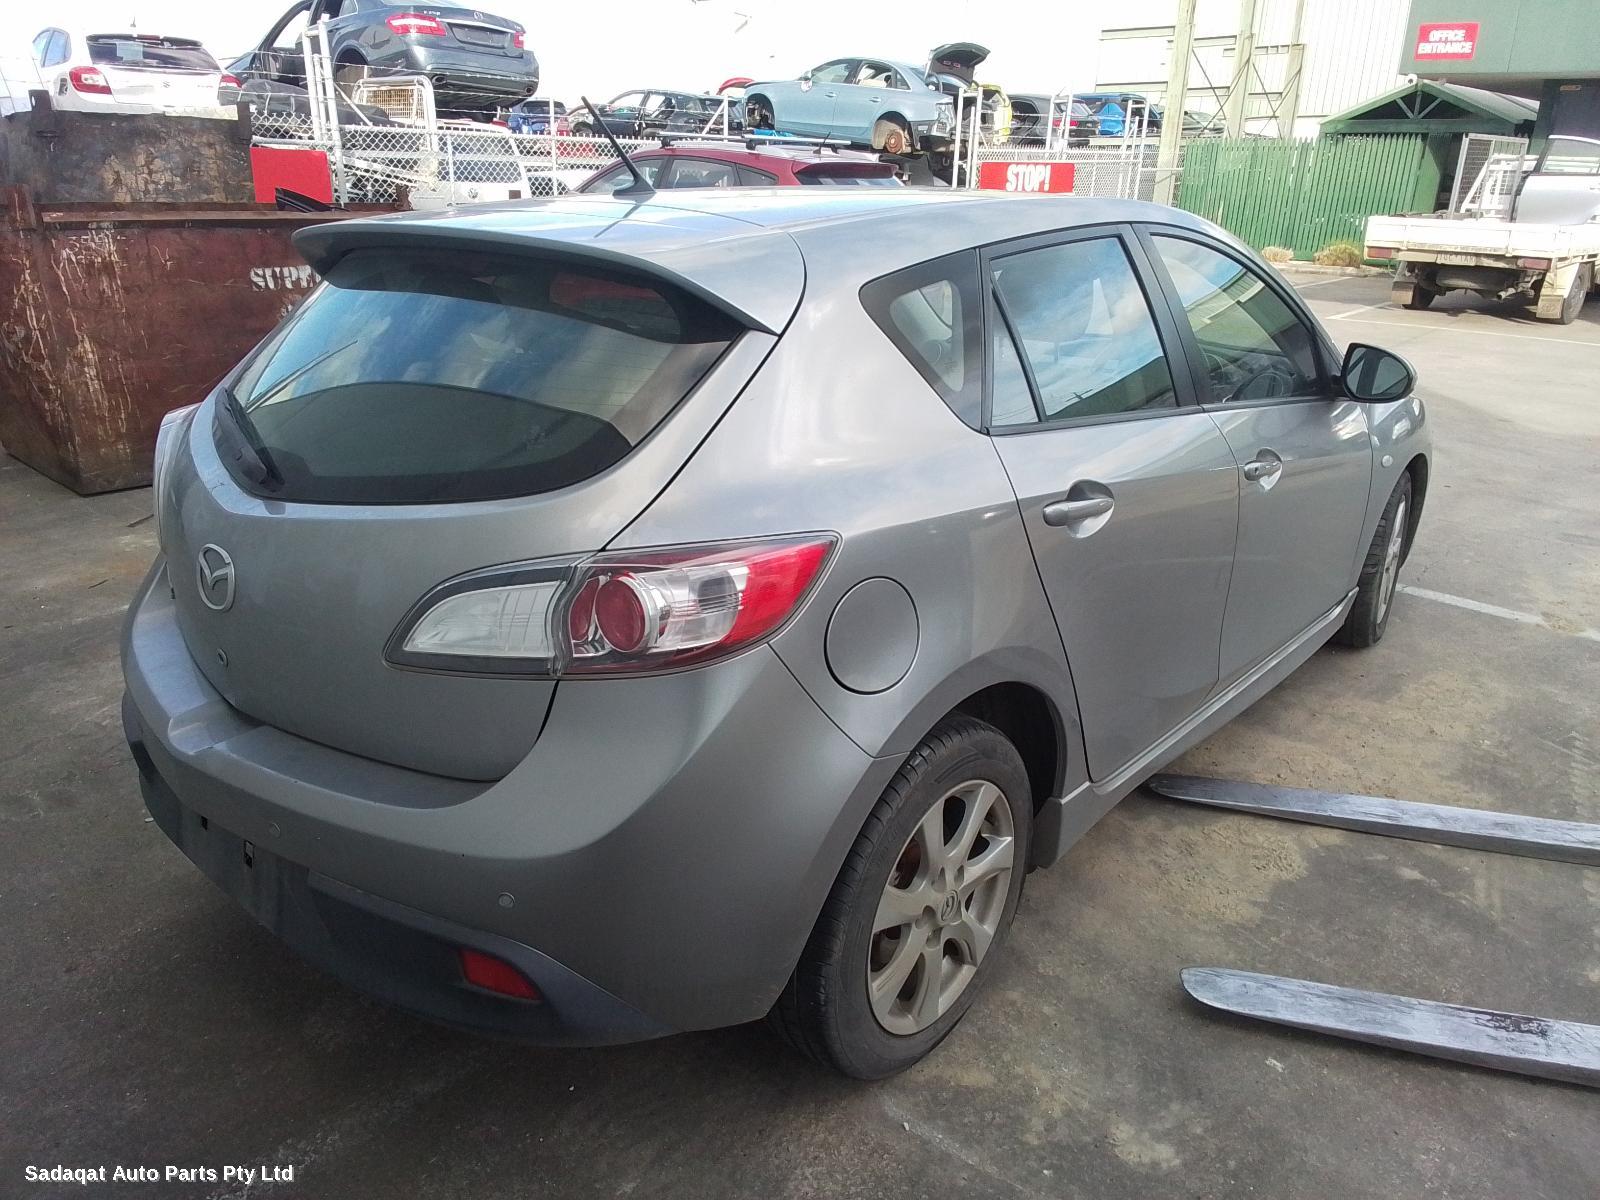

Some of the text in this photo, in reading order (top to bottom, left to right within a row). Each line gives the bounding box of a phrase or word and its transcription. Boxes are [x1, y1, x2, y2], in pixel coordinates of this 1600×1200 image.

[1429, 29, 1466, 42] OFFICE
[1417, 41, 1473, 54] ENTRANCE
[1006, 163, 1051, 191] STOP!
